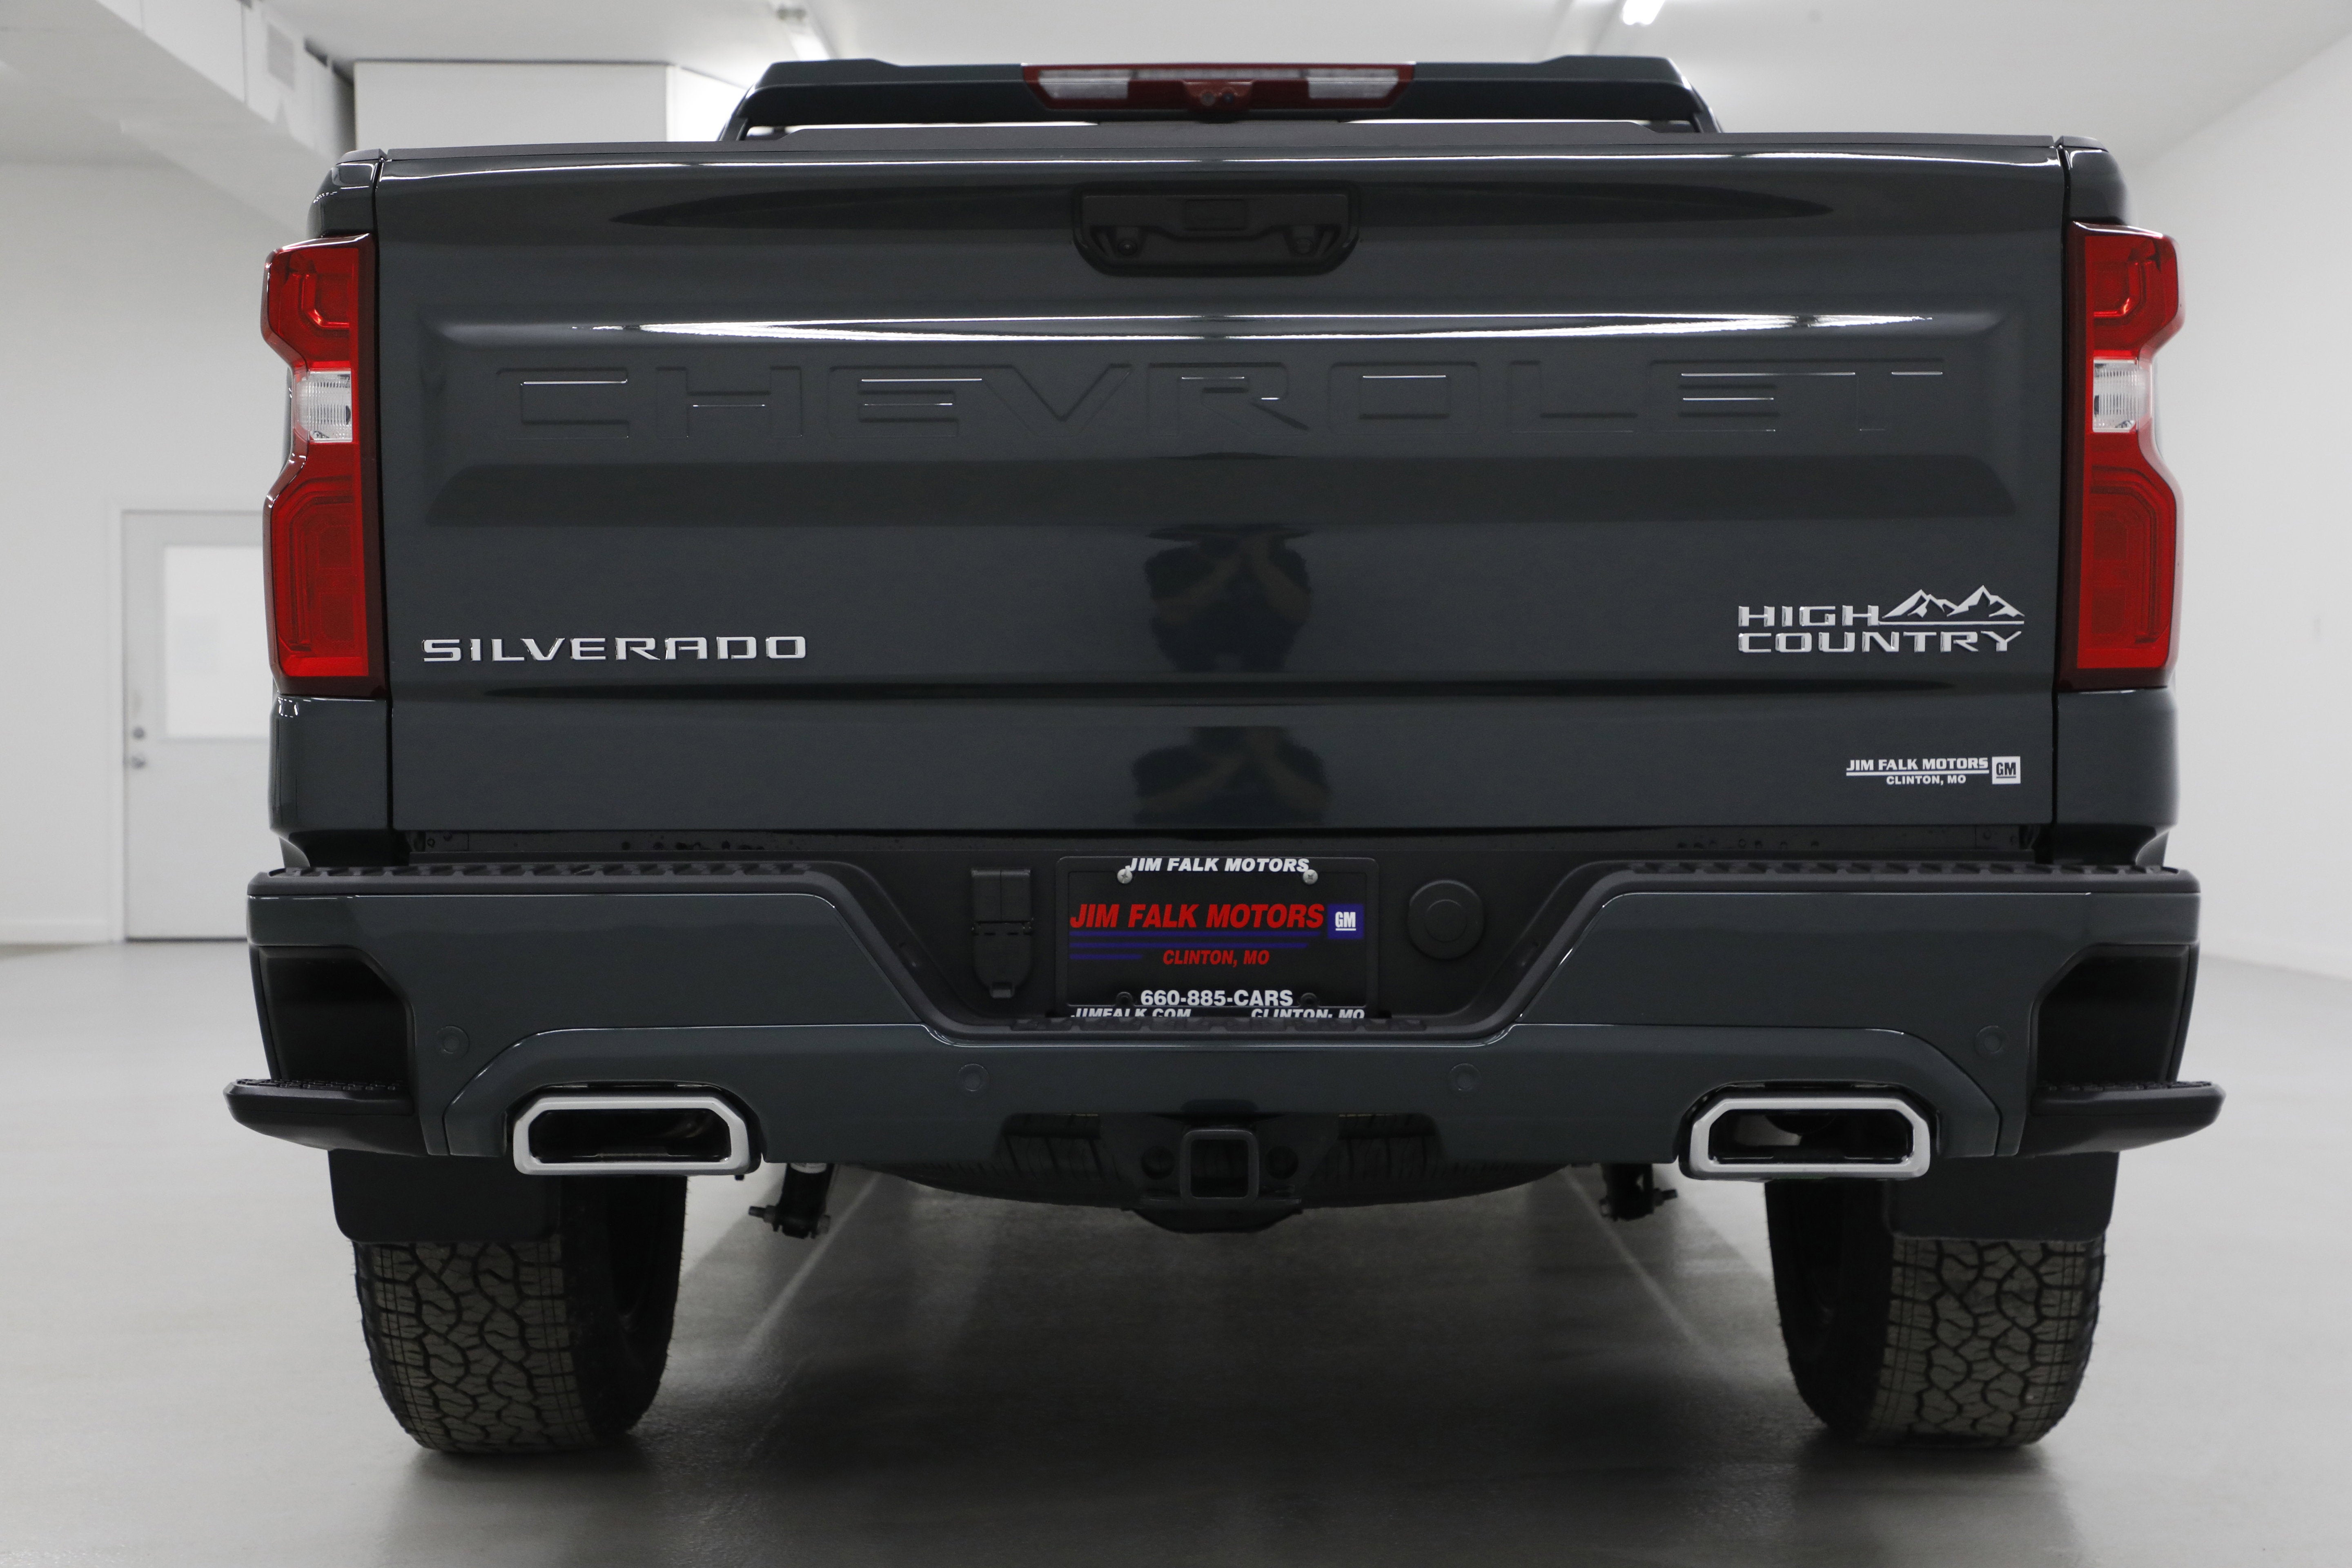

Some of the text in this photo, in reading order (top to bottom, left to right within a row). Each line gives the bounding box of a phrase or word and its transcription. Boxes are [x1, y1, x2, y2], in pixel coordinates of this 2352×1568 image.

[495, 358, 1945, 440] CHEVROLET
[1738, 605, 1879, 627] HIGH
[422, 636, 806, 662] SILVERADO
[1738, 631, 2022, 653] COUNTRY
[1846, 757, 1989, 771] JIM FALK MOTORS
[1996, 762, 2016, 776] GM
[1886, 775, 1967, 786] CLINTON, MO
[1125, 858, 1310, 872] JIM FALK MOTORS
[1070, 903, 1325, 929] JIM FALK MOTORS
[1335, 911, 1356, 928] GM
[1163, 950, 1270, 968] CLINTON, MO
[1140, 989, 1294, 1006] 660-885-CARS
[1070, 1008, 1192, 1017] JIMFALKCOM
[1338, 1009, 1365, 1018] MO
